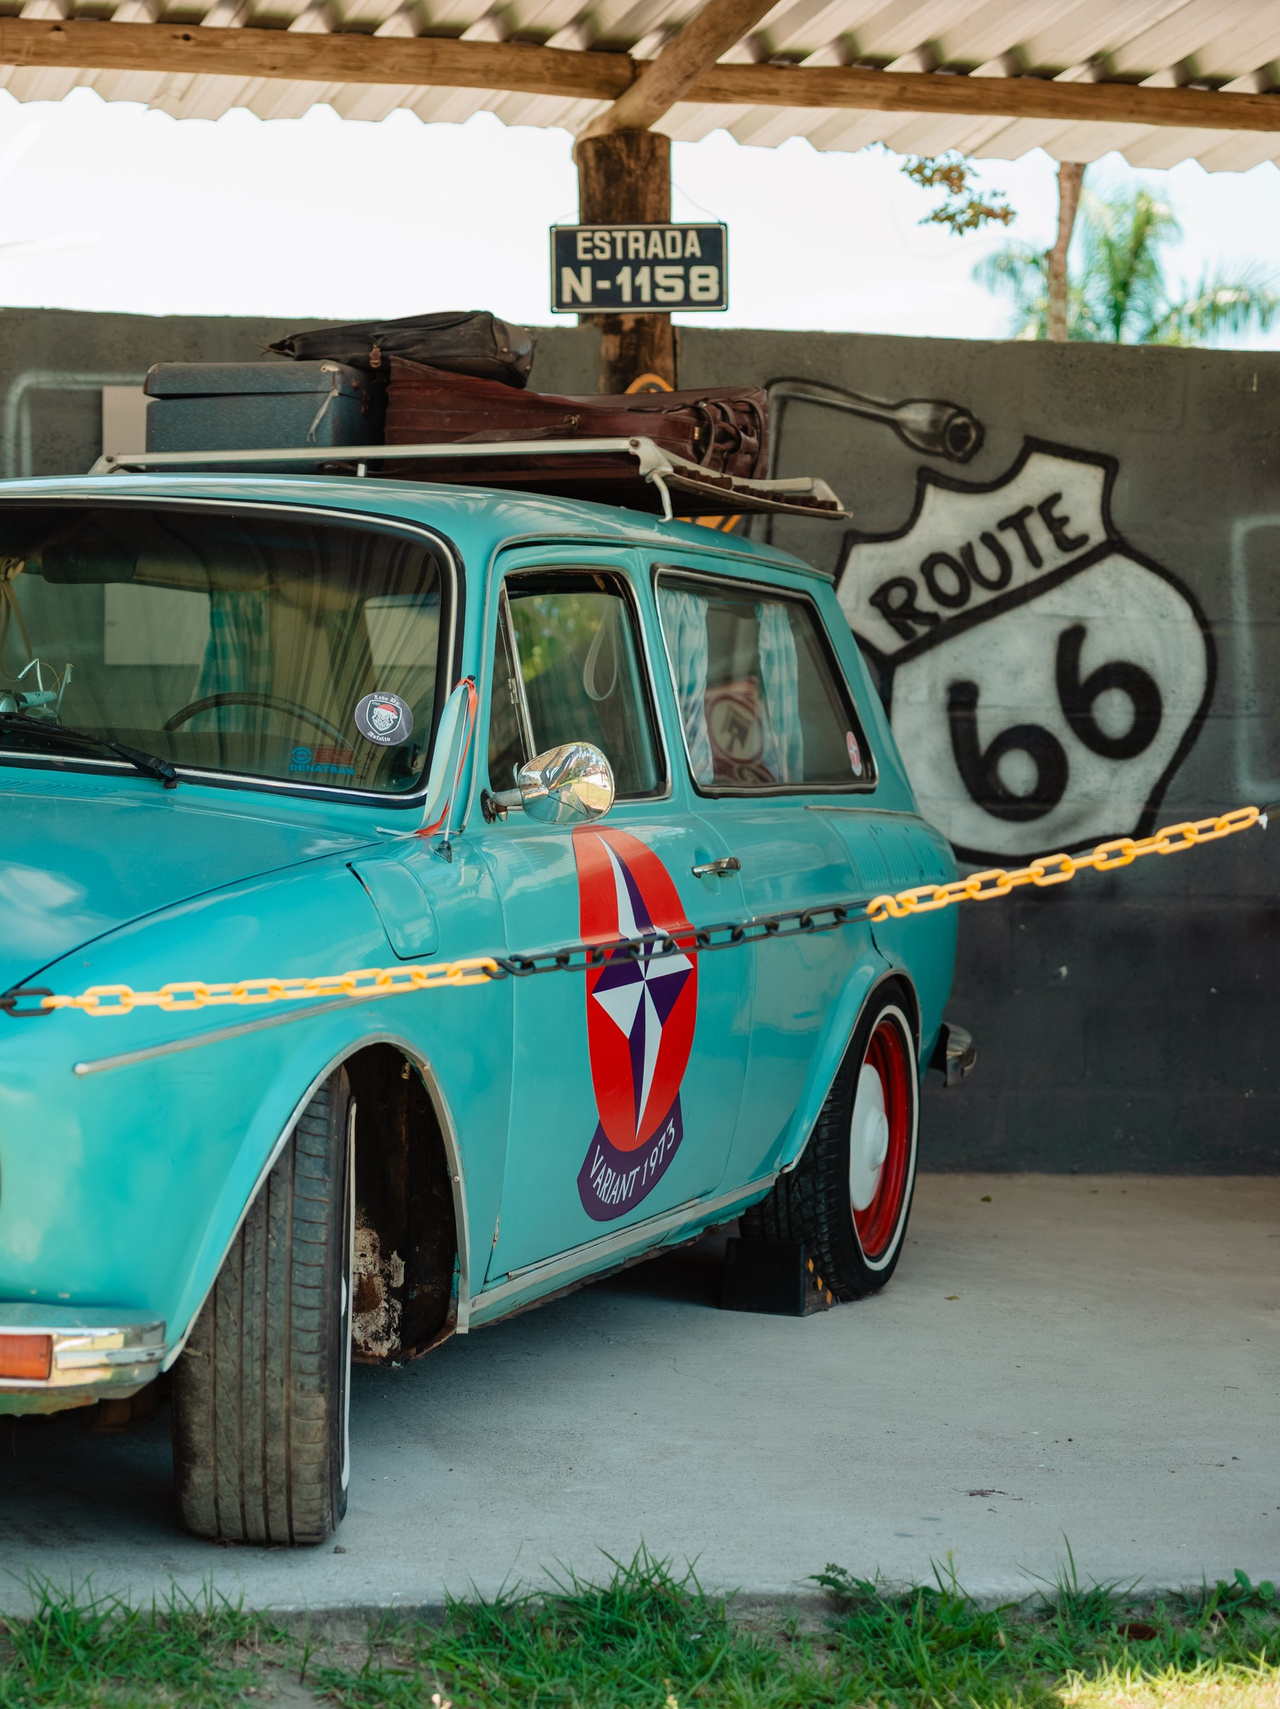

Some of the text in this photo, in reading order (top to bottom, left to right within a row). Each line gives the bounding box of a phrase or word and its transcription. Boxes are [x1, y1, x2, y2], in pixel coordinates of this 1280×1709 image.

[576, 230, 702, 260] ESTRADA
[561, 265, 720, 303] N-1158
[870, 492, 1089, 641] ROUTE
[946, 622, 1163, 822] 66
[289, 764, 355, 776] DENATRAN
[589, 1117, 676, 1205] VARIANT 1973
